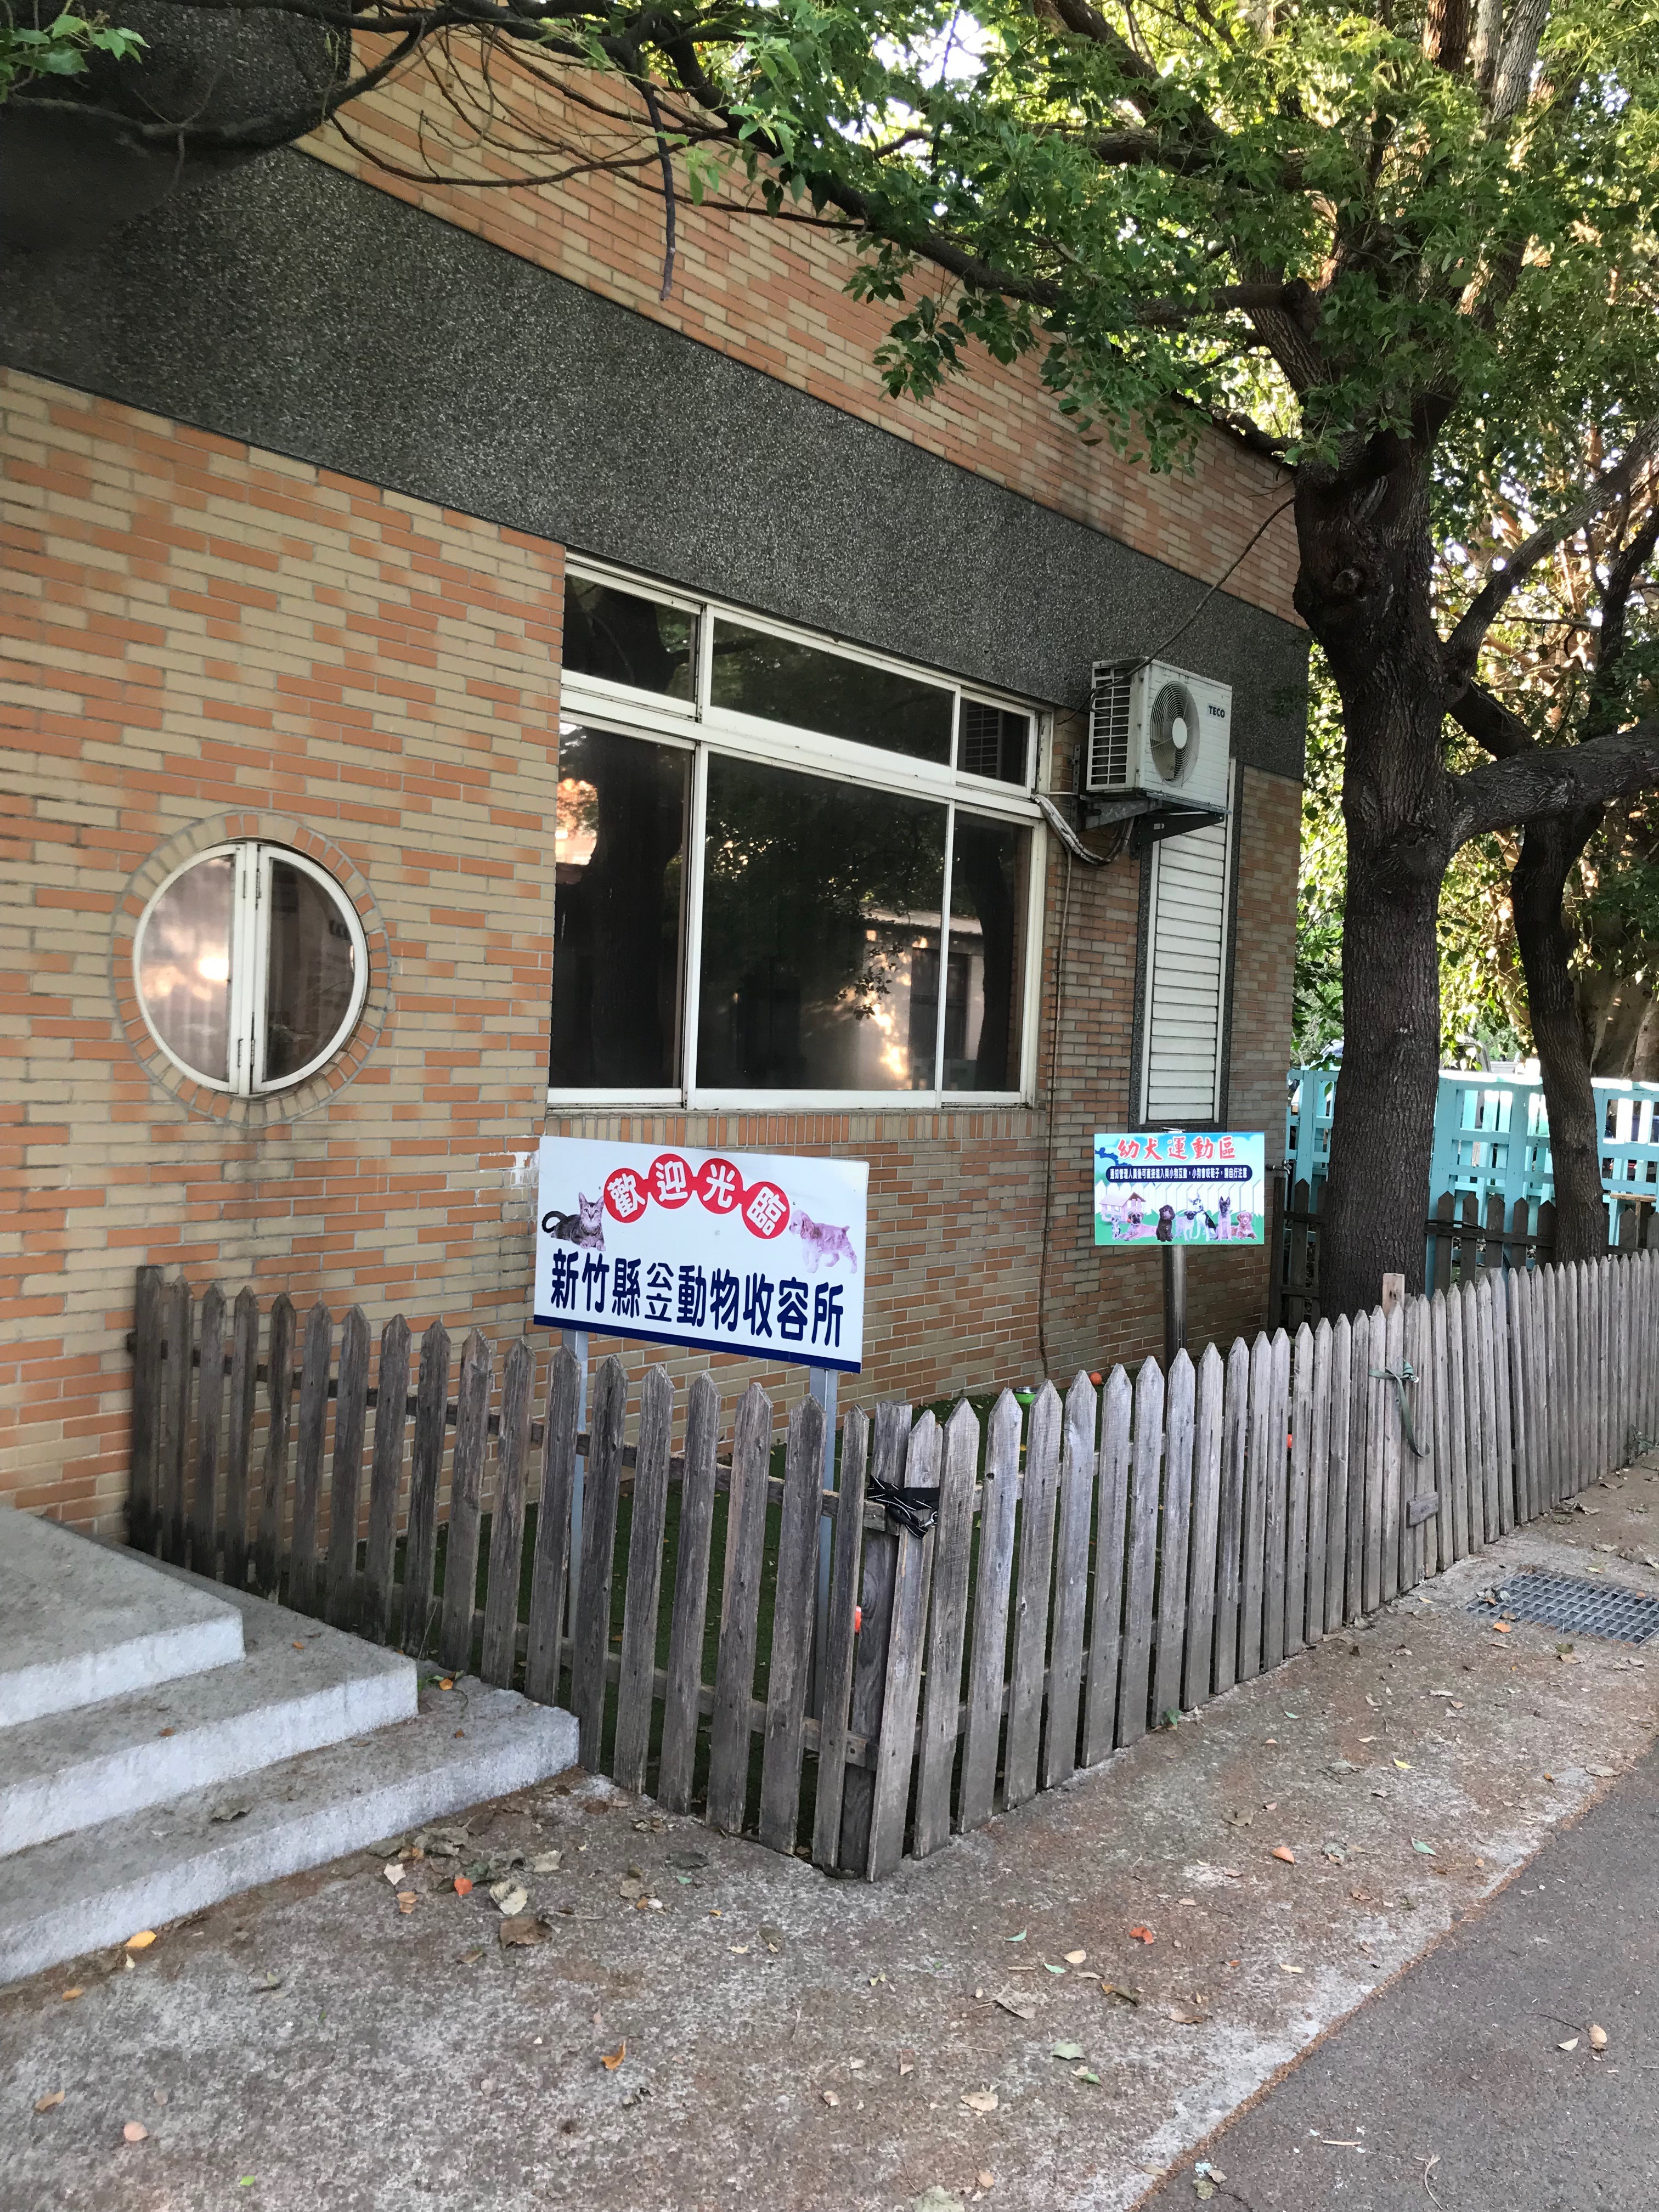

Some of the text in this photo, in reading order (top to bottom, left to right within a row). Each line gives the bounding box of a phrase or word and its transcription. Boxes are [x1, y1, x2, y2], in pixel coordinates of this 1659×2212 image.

[1209, 706, 1225, 718] TECO
[1117, 1136, 1236, 1160] 幼犬運動區
[607, 1160, 787, 1236] 歡迎光臨
